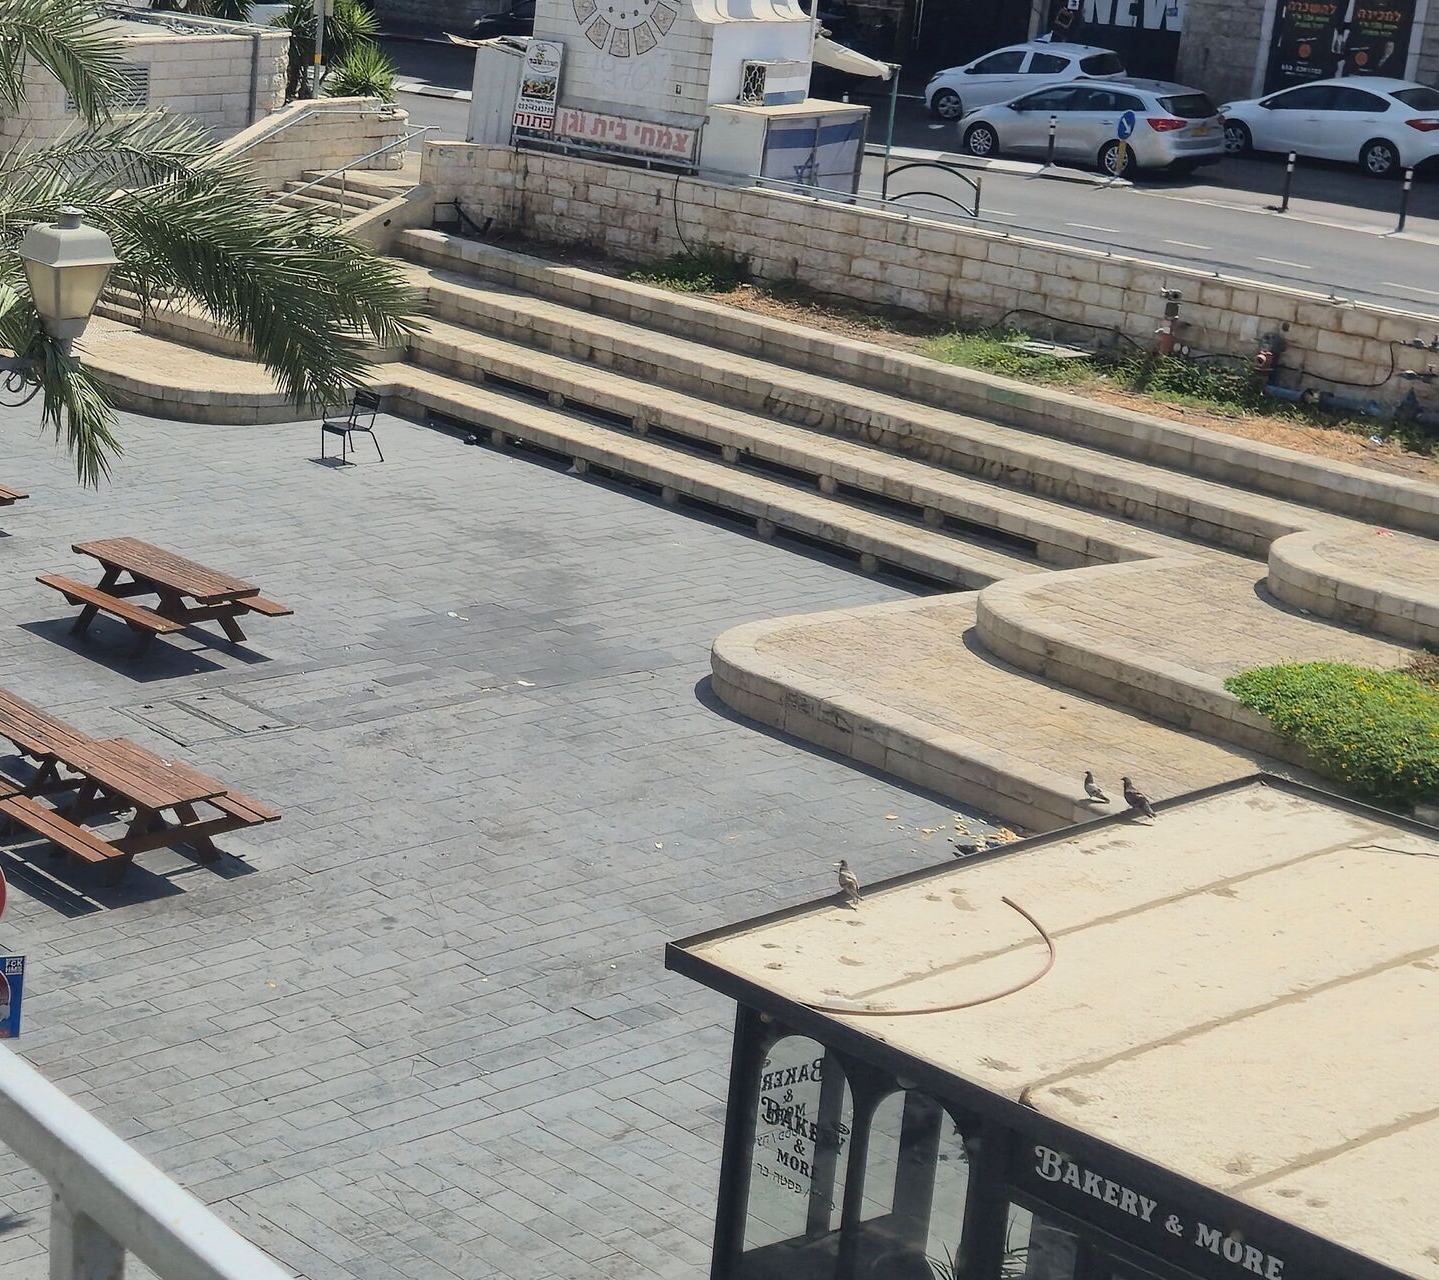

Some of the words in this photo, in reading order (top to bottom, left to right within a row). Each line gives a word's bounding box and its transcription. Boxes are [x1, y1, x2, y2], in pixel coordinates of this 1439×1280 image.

[514, 112, 553, 130] פתוח
[562, 110, 585, 136] וגן
[590, 118, 628, 141] בית
[635, 125, 690, 153] צמחי
[1034, 1145, 1158, 1223] BAKERY
[1165, 1214, 1184, 1238] &
